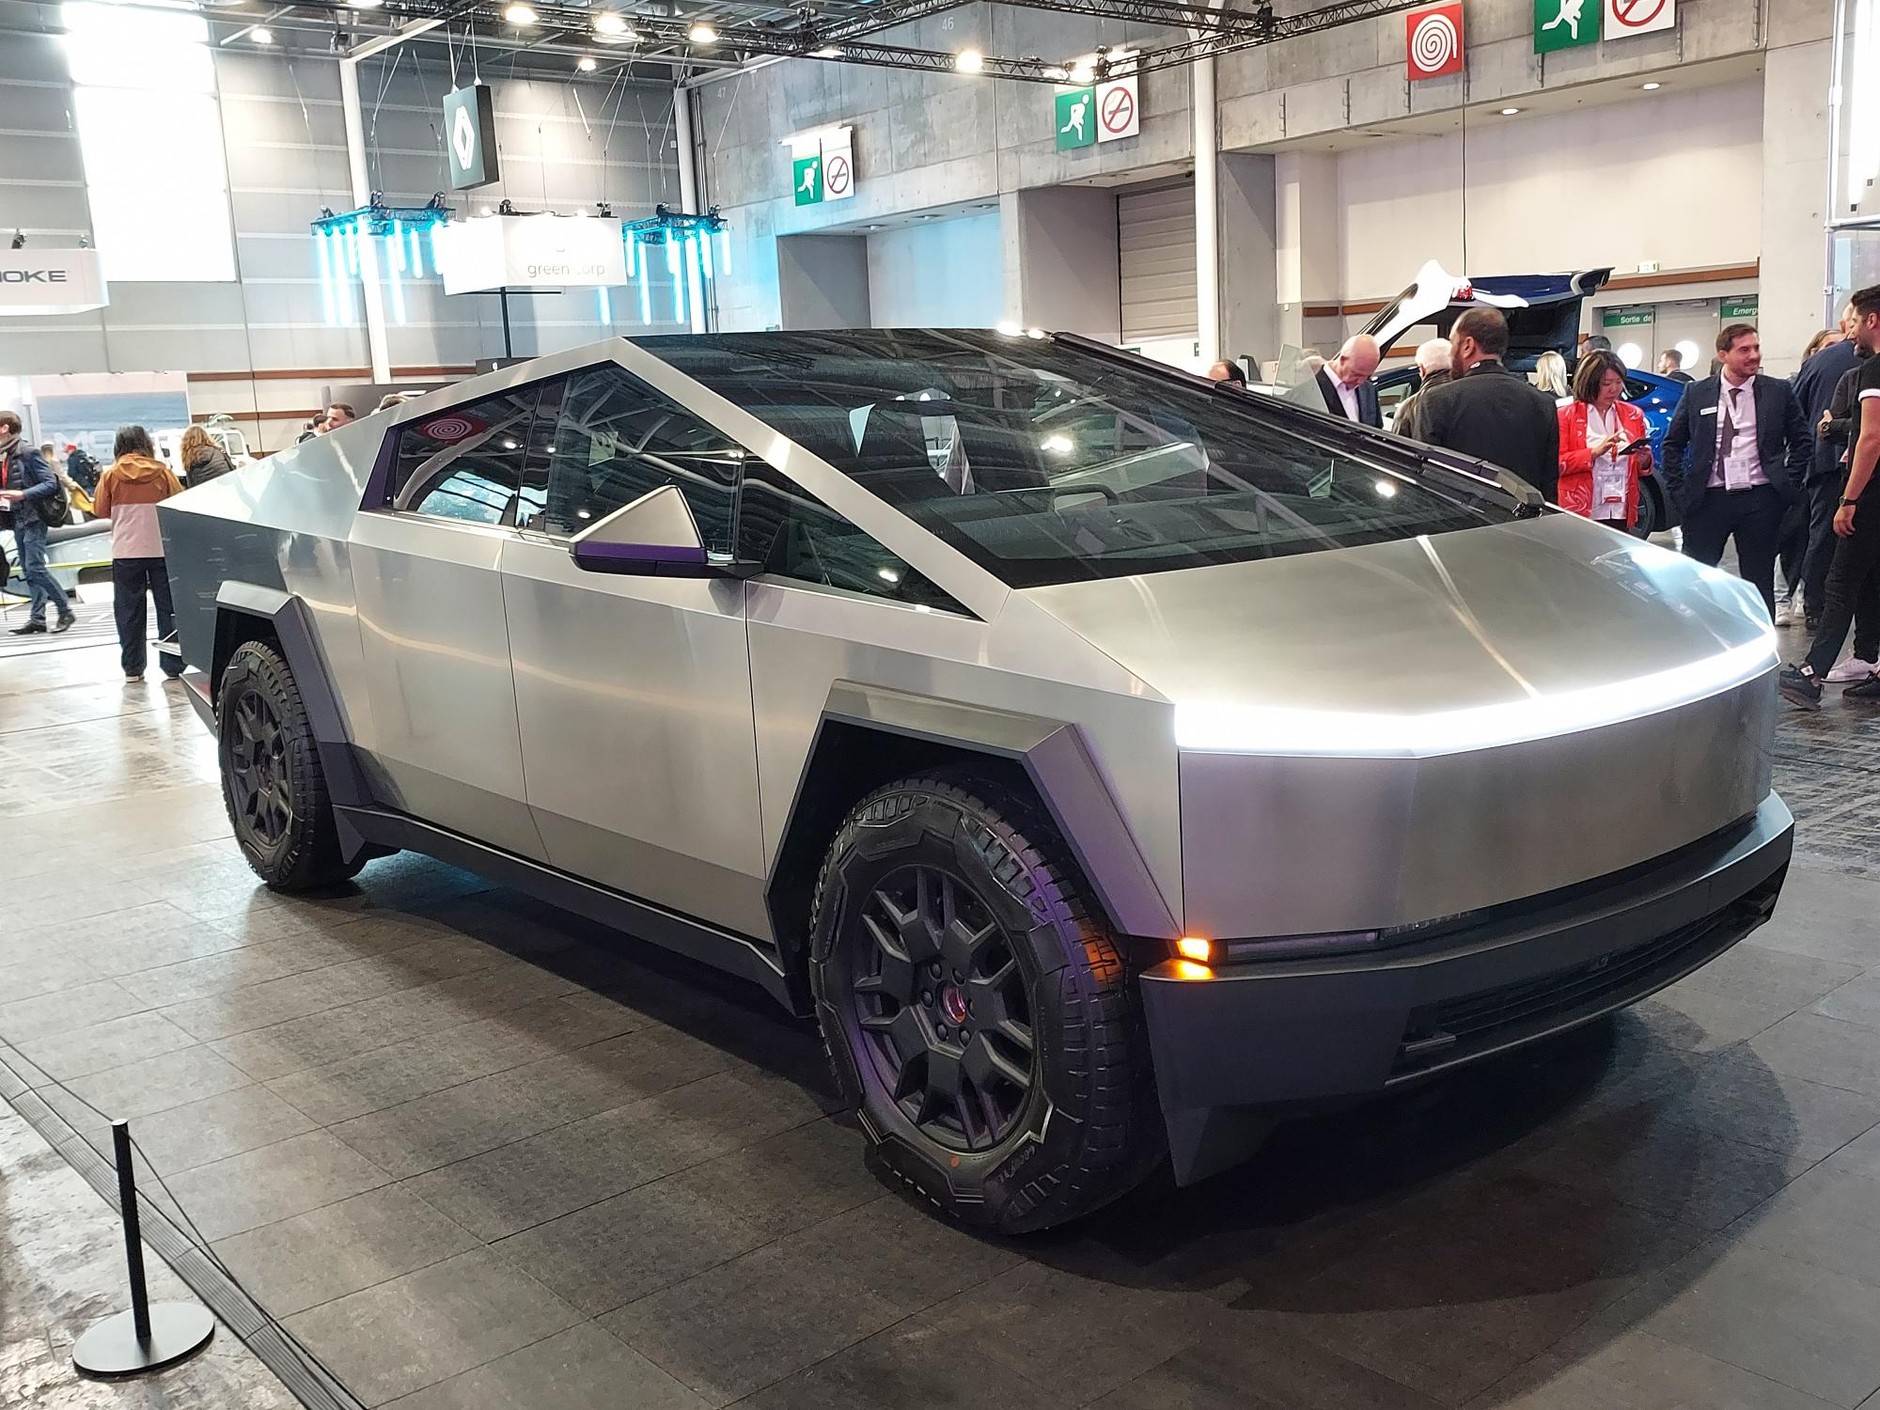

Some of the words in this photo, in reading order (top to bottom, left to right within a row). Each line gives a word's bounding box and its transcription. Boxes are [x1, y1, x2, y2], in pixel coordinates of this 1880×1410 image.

[941, 16, 954, 31] 46
[0, 270, 68, 283] OKE
[527, 264, 570, 279] green
[575, 265, 606, 279] orp
[1620, 316, 1640, 324] Sortie
